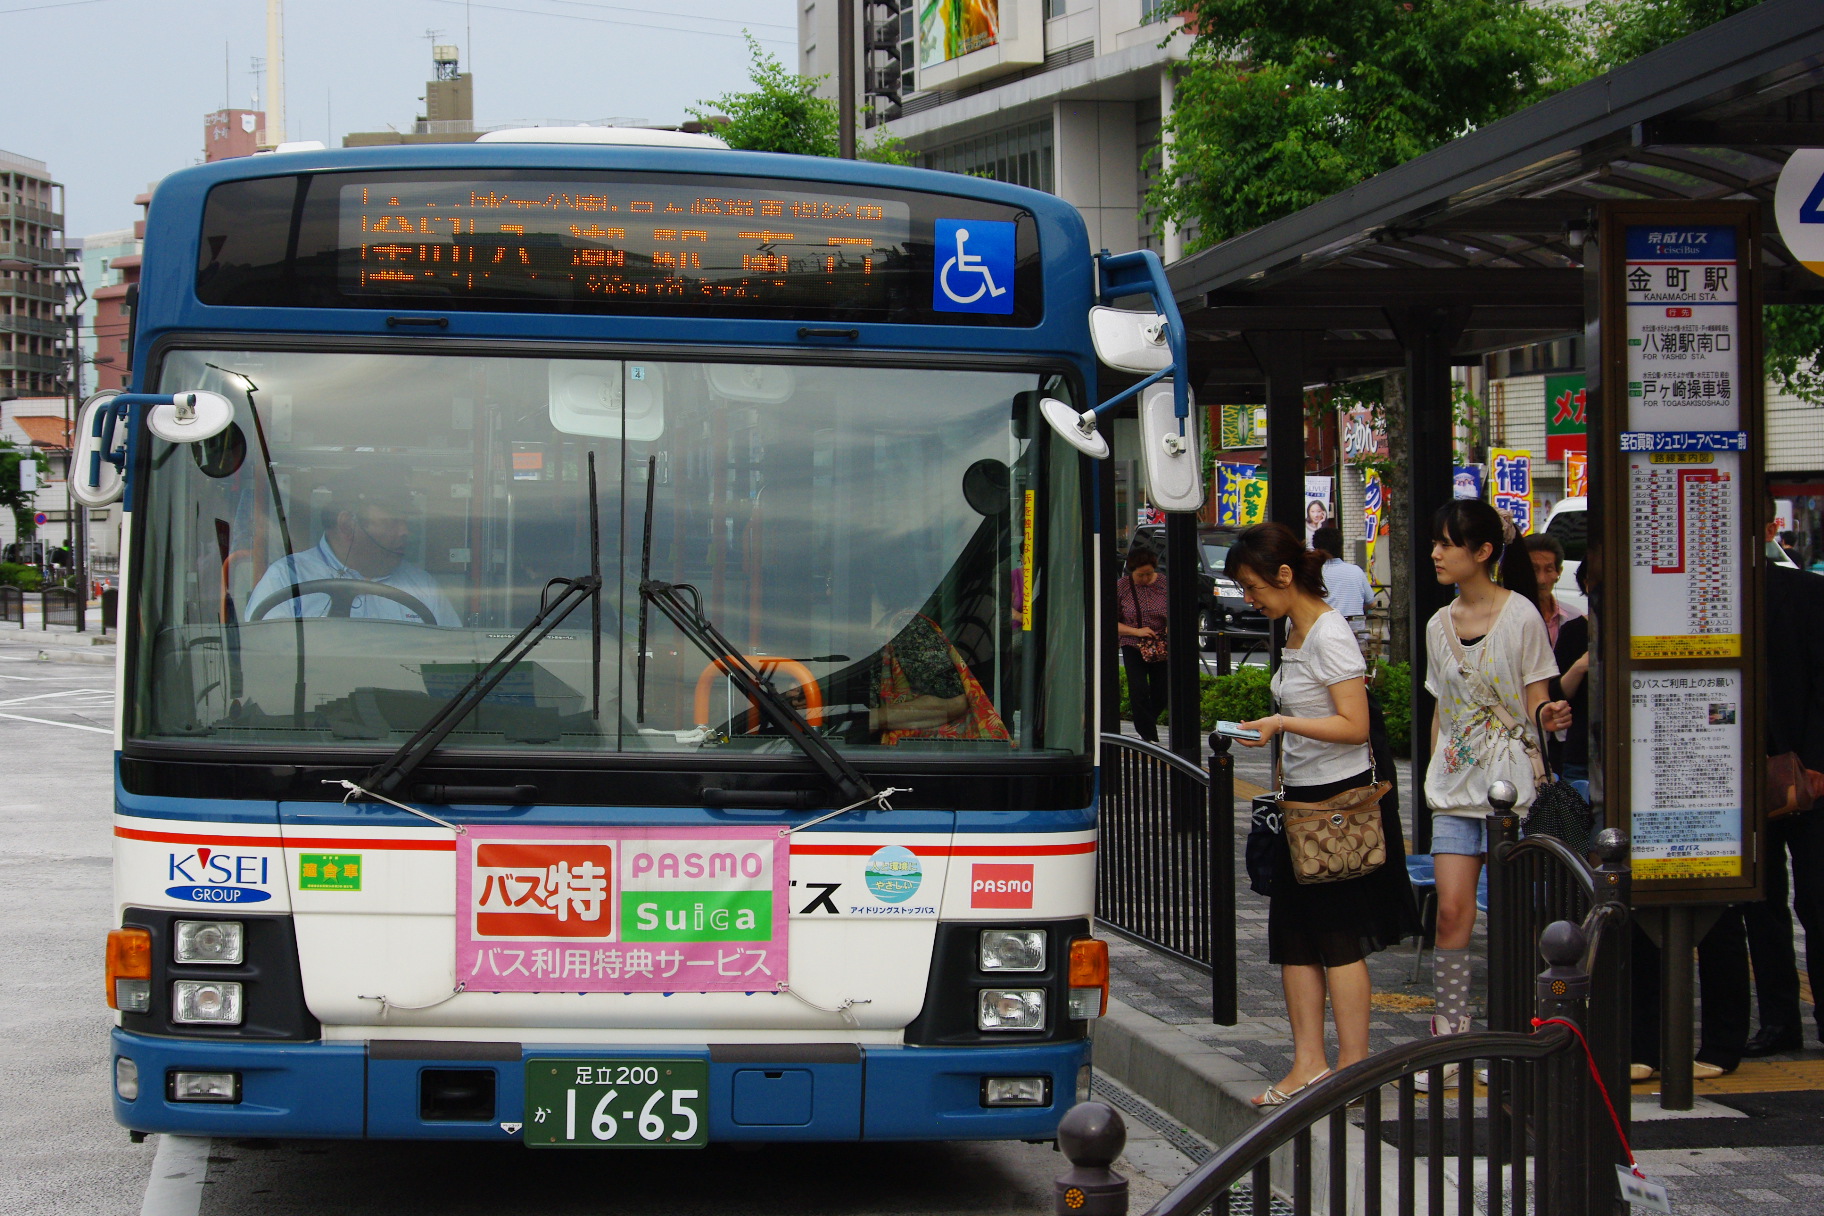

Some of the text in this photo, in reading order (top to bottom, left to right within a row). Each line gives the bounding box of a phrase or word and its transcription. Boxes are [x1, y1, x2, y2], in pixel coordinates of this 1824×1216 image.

[1648, 232, 1708, 244] 京成バス
[1628, 266, 1728, 292] 金町駅
[1644, 293, 1718, 301] KANAMACHI STA.
[1668, 309, 1691, 317] 行先
[1642, 333, 1730, 353] 八潮駅南口
[1643, 380, 1731, 399] 戸ヶ崎操車場
[1344, 417, 1378, 454] らーめん
[1620, 432, 1747, 451] 宝石買取 ジュエリーアベニュー前
[1654, 453, 1709, 463] 路線案内図
[302, 863, 359, 879] 適合車
[631, 852, 763, 879] PASMO
[869, 860, 919, 872] 人と環境に
[478, 860, 607, 922] バス特
[875, 880, 914, 890] やさしい
[973, 879, 1032, 893] PASMO
[192, 888, 241, 902] GROUP
[788, 880, 842, 914] ス
[636, 902, 756, 931] Suica
[850, 906, 936, 915] アイドリングストップバス
[471, 947, 772, 979] バス利用特典サービス
[534, 1106, 552, 1124] か
[566, 1088, 699, 1141] 16-65
